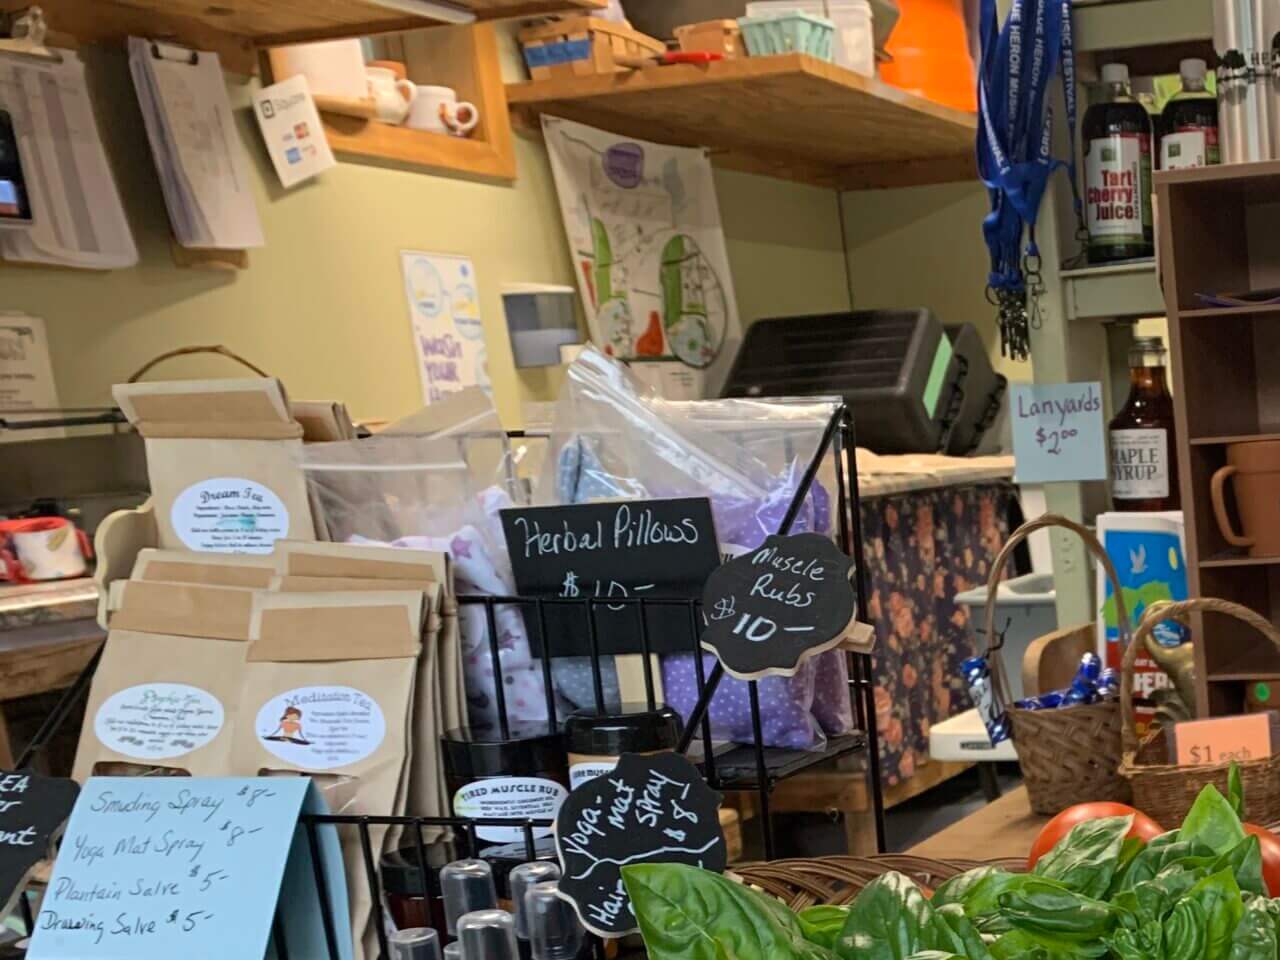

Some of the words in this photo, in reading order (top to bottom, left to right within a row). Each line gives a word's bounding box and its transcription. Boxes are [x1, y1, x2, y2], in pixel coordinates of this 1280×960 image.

[1009, 25, 1022, 75] HERON
[1101, 169, 1133, 187] Tart
[1088, 187, 1133, 204] Cherry
[1096, 203, 1134, 221] Juice
[1018, 385, 1100, 426] Lanyards
[200, 489, 240, 504] Dream
[515, 517, 602, 557] Herbal
[614, 505, 699, 549] Pillows
[751, 548, 825, 581] Muscle
[750, 573, 816, 608] Rubs
[0, 773, 30, 793] EA
[490, 784, 536, 795] MUSCLE
[168, 789, 225, 822] Spray
[75, 834, 105, 866] Yoga
[113, 834, 149, 857] Mat
[153, 828, 207, 862] Spray
[55, 876, 121, 902] Plantain
[128, 876, 181, 897] Salve
[110, 912, 156, 936] Salve
